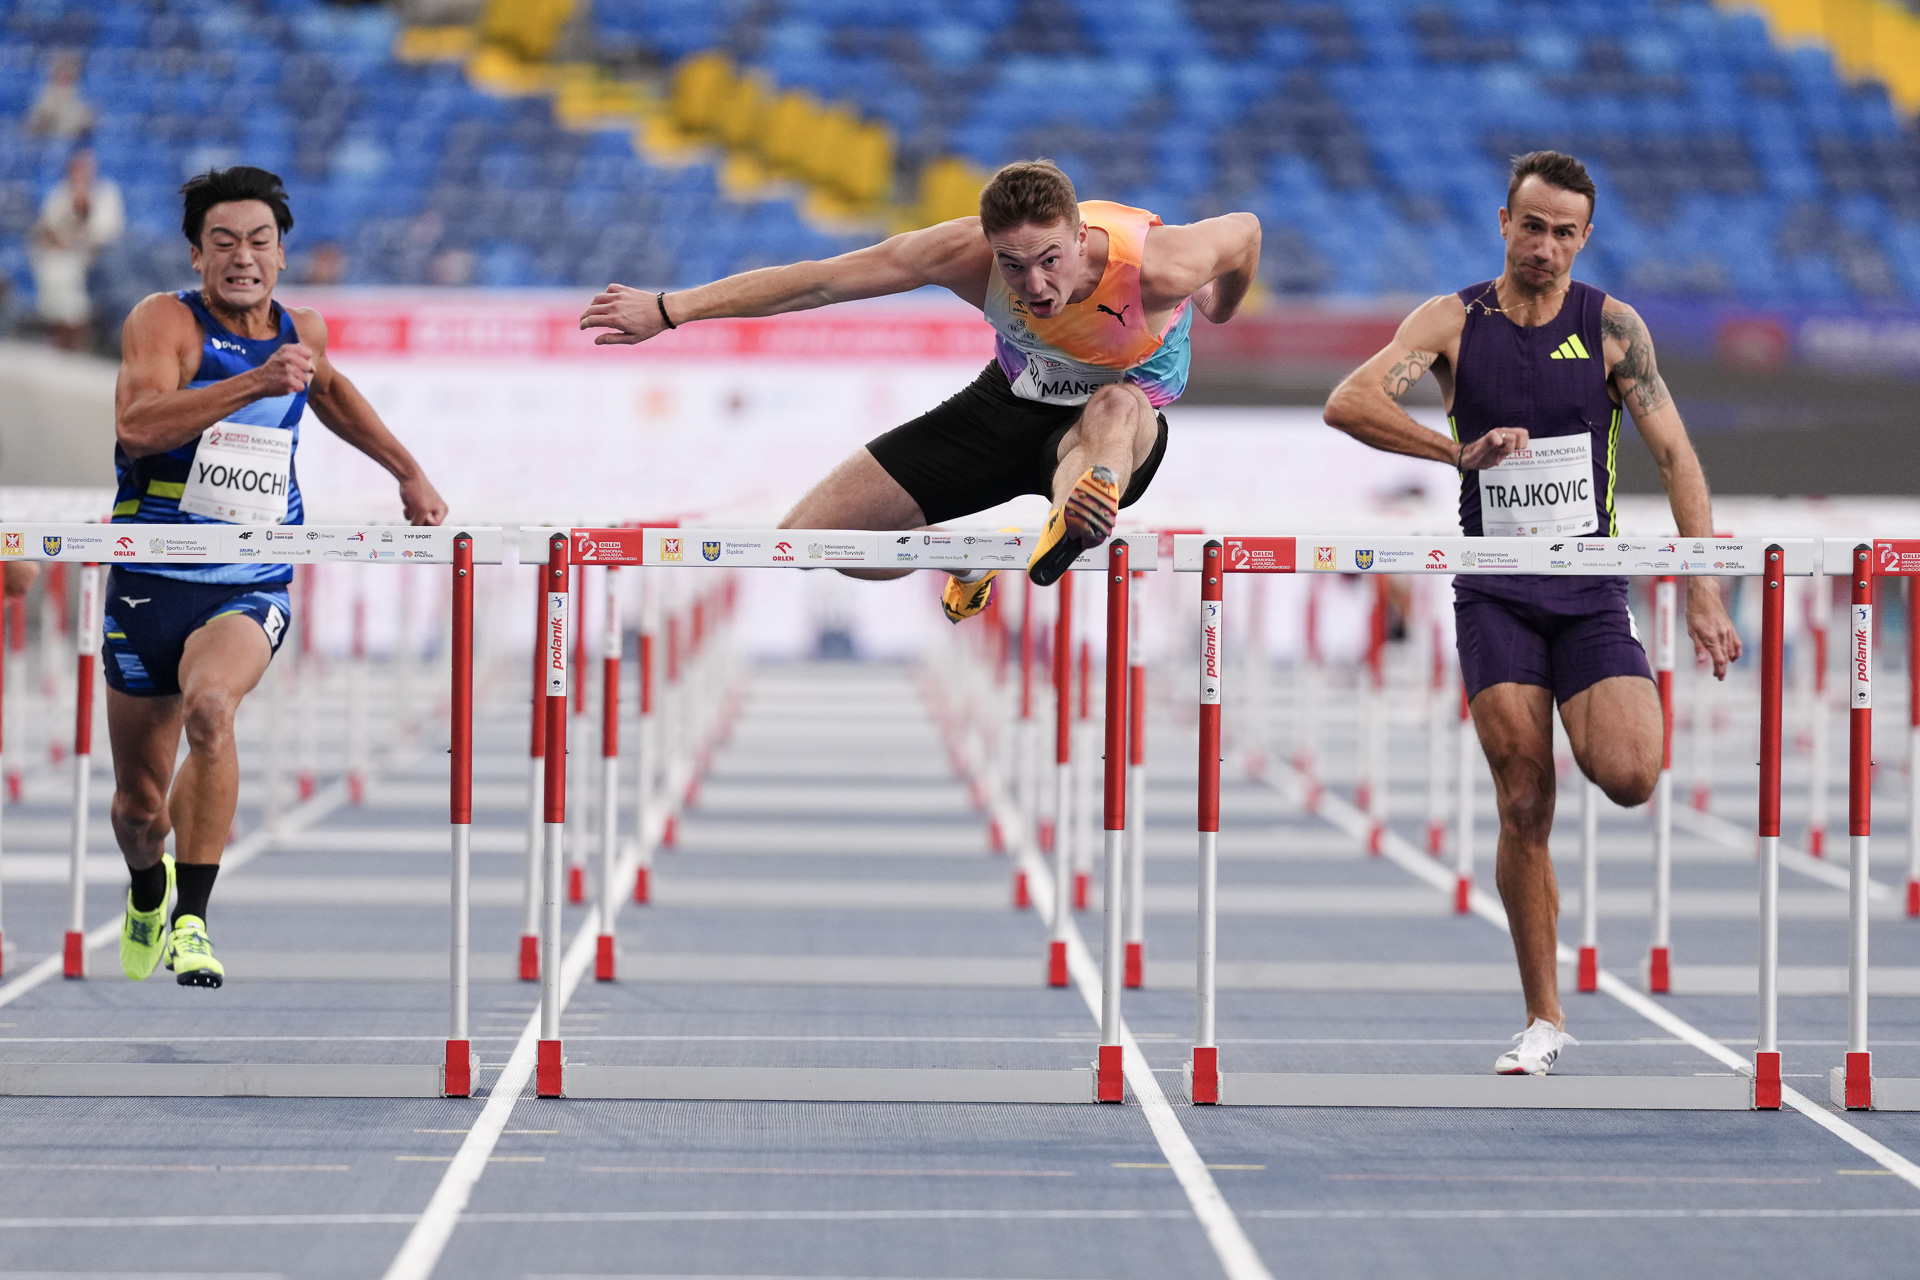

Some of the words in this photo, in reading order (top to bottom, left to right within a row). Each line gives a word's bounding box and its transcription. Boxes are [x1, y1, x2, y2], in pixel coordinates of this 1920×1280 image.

[1030, 358, 1118, 397] SZMAŃS
[1536, 446, 1587, 457] MEMORIAŁ
[199, 462, 286, 496] YOKOCHI
[1486, 478, 1588, 508] TRAJKOVIC
[575, 532, 597, 560] 72
[1228, 541, 1250, 569] 72
[1878, 543, 1900, 571] 72
[551, 617, 564, 670] polanik
[1205, 625, 1217, 678] polanik
[1855, 629, 1868, 682] polanik
